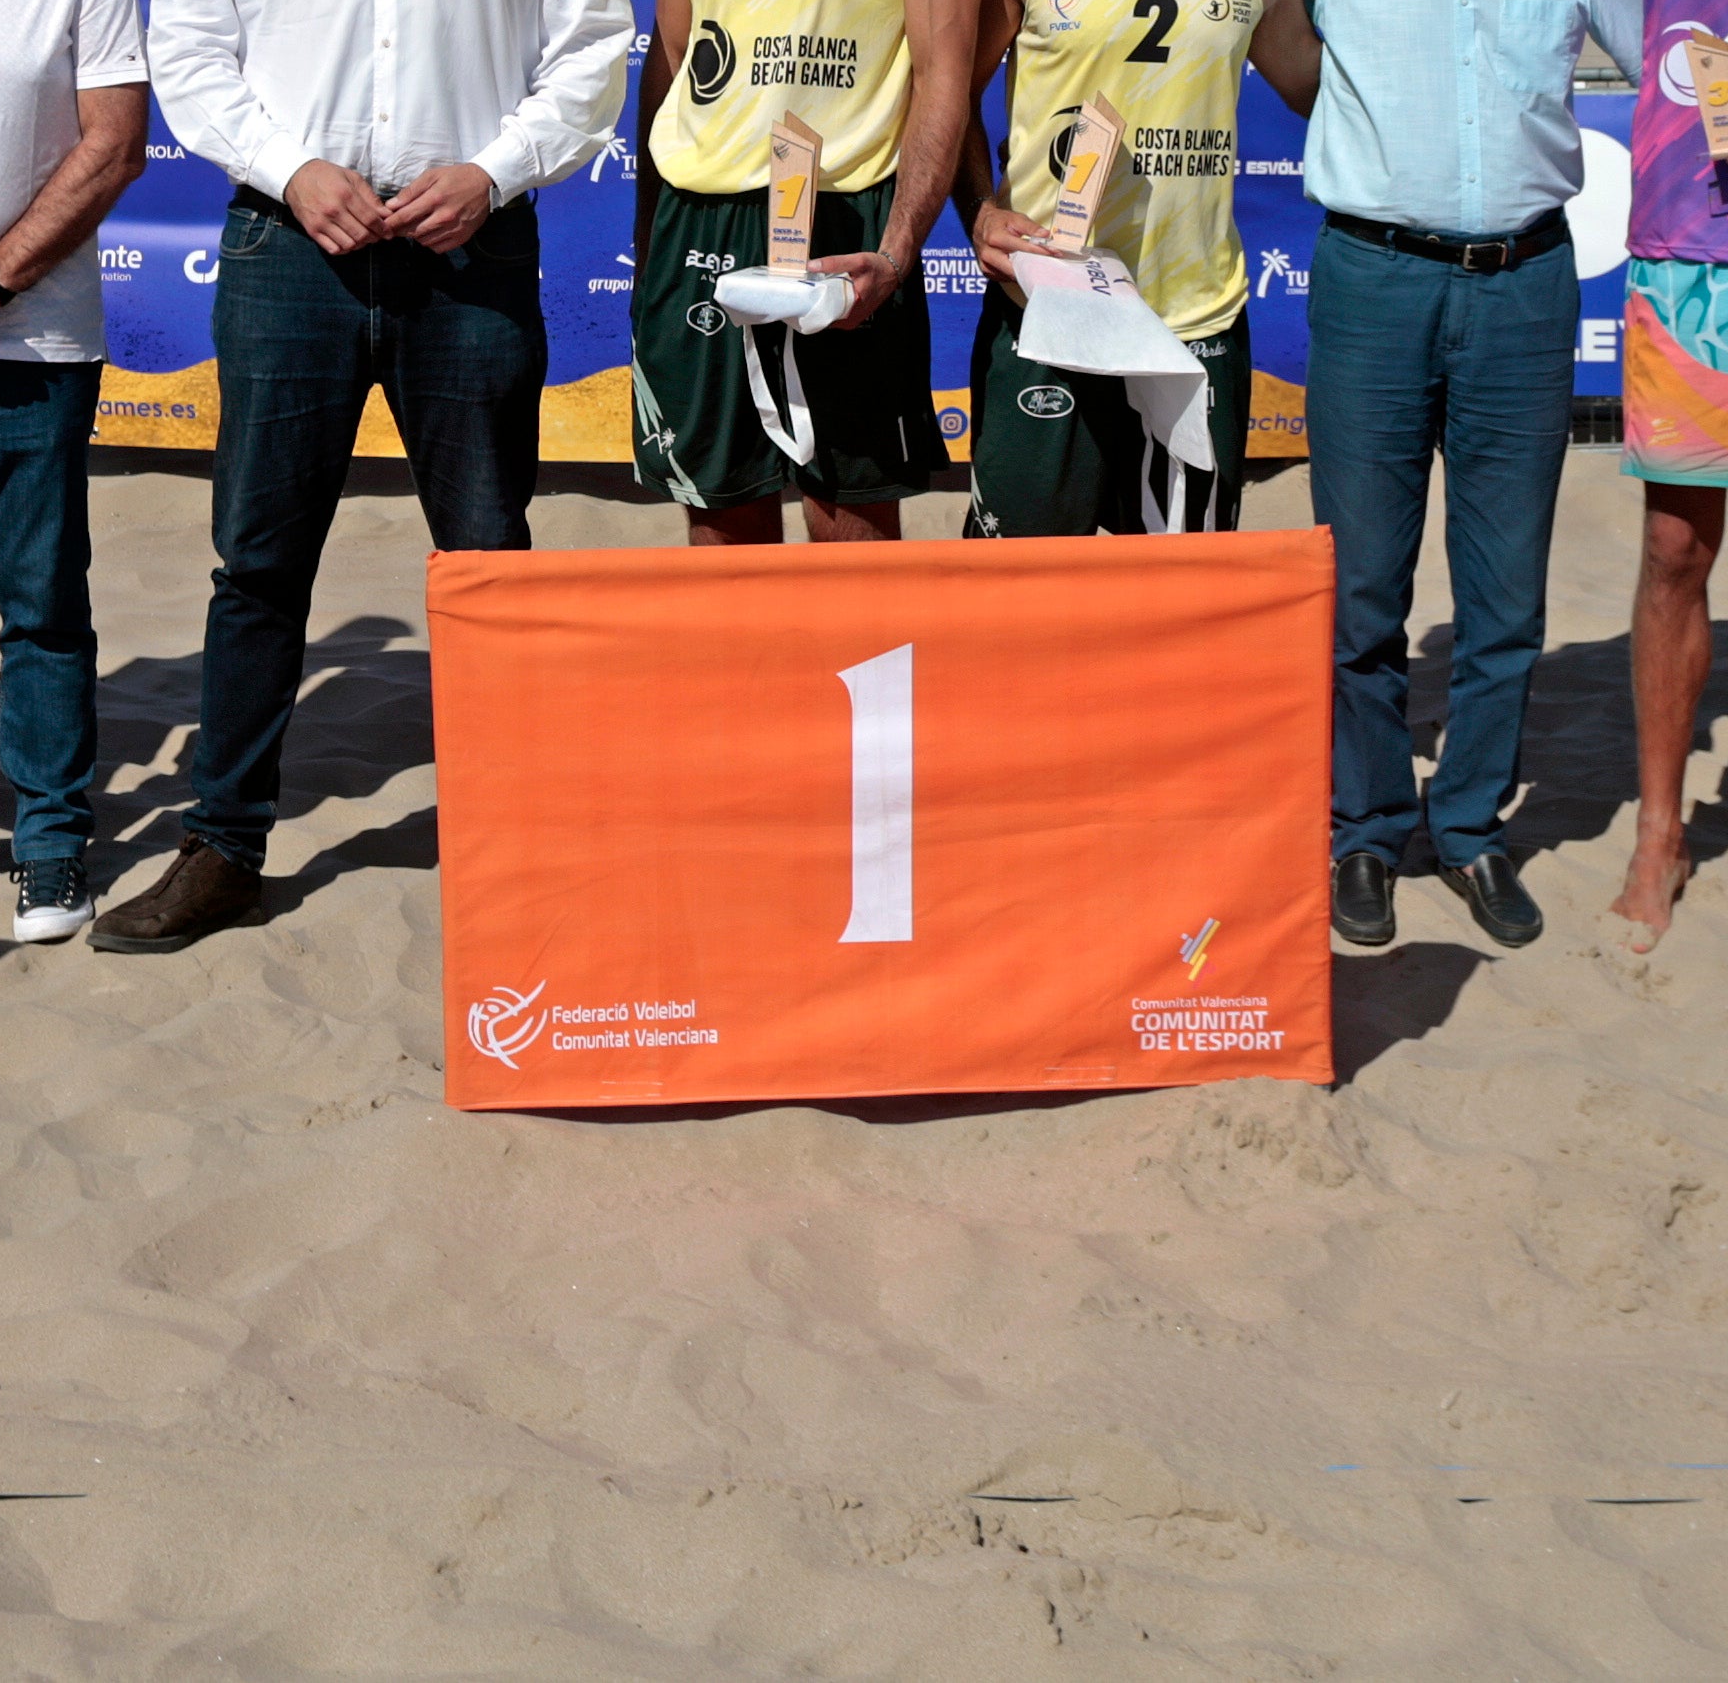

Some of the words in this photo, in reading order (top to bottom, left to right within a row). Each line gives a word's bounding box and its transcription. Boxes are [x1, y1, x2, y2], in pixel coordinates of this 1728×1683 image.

[753, 34, 793, 60] COSTA
[797, 34, 858, 63] BLANCA
[800, 61, 856, 90] GAMES
[1134, 127, 1181, 151] COSTA
[1184, 127, 1232, 152] BLANCA
[1065, 151, 1100, 195] 1
[1132, 153, 1183, 177] BEACH
[1186, 153, 1230, 178] GAMES
[776, 173, 808, 218] 1
[923, 276, 948, 294] DE
[835, 641, 914, 944] 1
[552, 1003, 629, 1025] Federació
[634, 999, 696, 1021] Voleibol
[1131, 996, 1198, 1011] Comunitat
[1199, 994, 1269, 1009] Valenciana
[1130, 1009, 1270, 1033] COMUNITAT
[552, 1029, 630, 1051] Comunitat
[633, 1025, 719, 1049] Valenciana
[1140, 1031, 1172, 1051] DE
[1176, 1029, 1286, 1052] L'ESPORT
